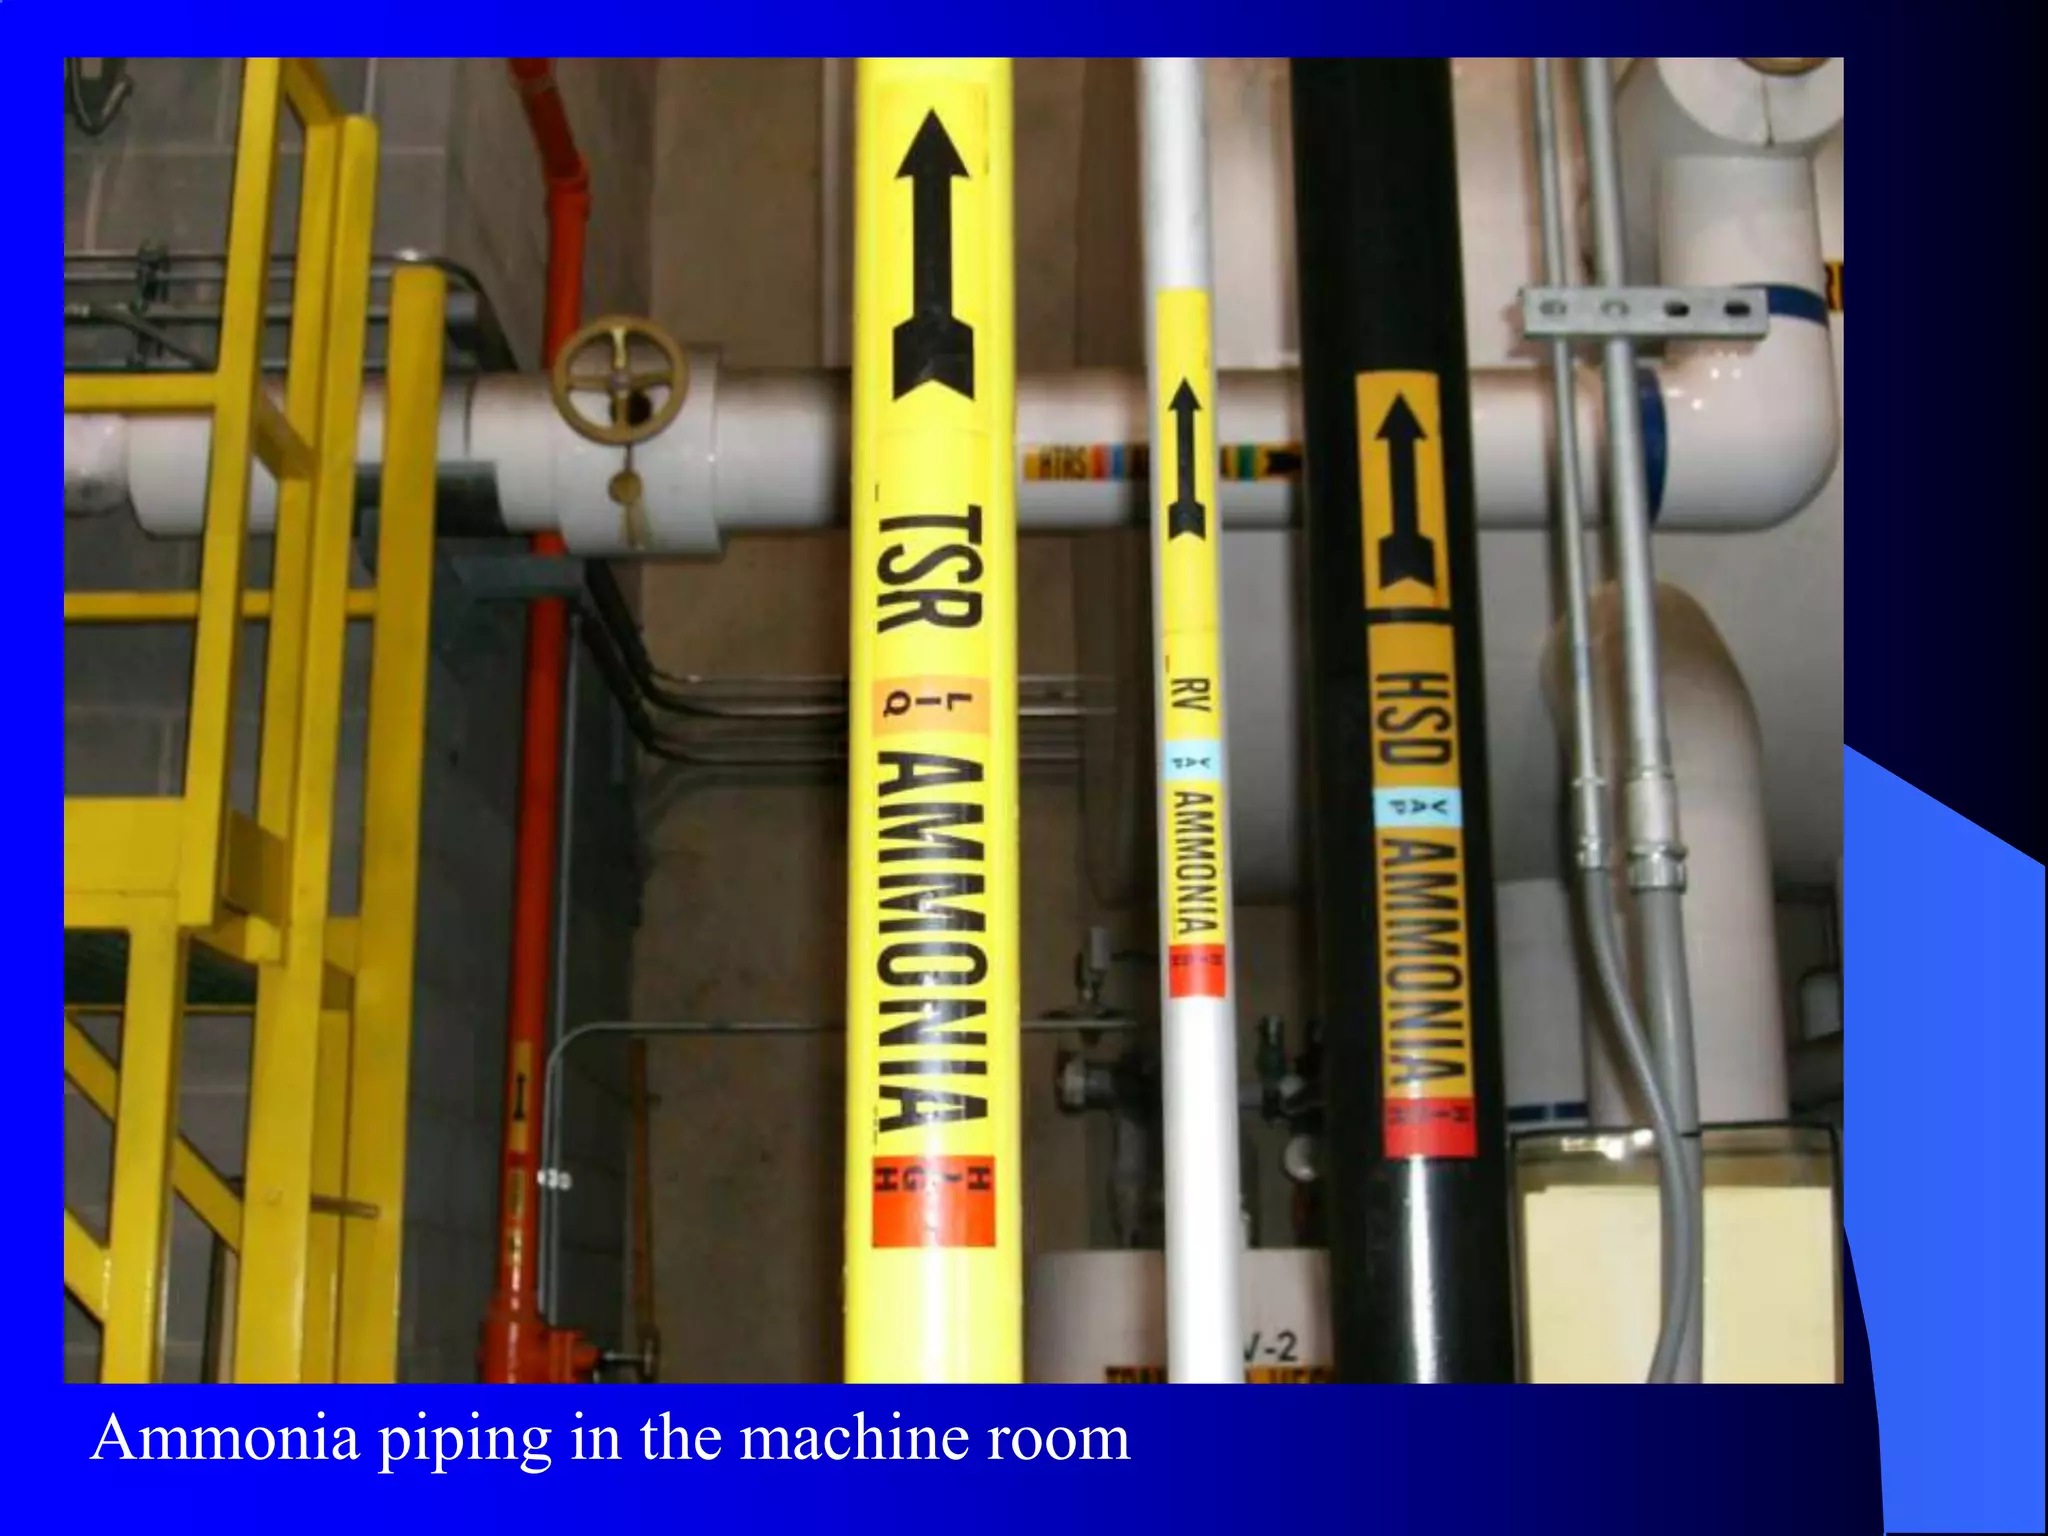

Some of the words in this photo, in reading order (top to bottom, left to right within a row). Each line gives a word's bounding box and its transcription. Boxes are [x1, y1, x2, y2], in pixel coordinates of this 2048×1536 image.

[877, 504, 983, 633] TSR
[883, 690, 972, 717] LIQ
[1171, 678, 1211, 712] RV
[1377, 672, 1453, 765] HSD
[1173, 757, 1210, 768] VAP
[1389, 800, 1447, 814] VAP
[1174, 791, 1218, 935] AMMONIA
[877, 752, 988, 1132] AMMONIA
[1382, 838, 1466, 1085] AMMONIA
